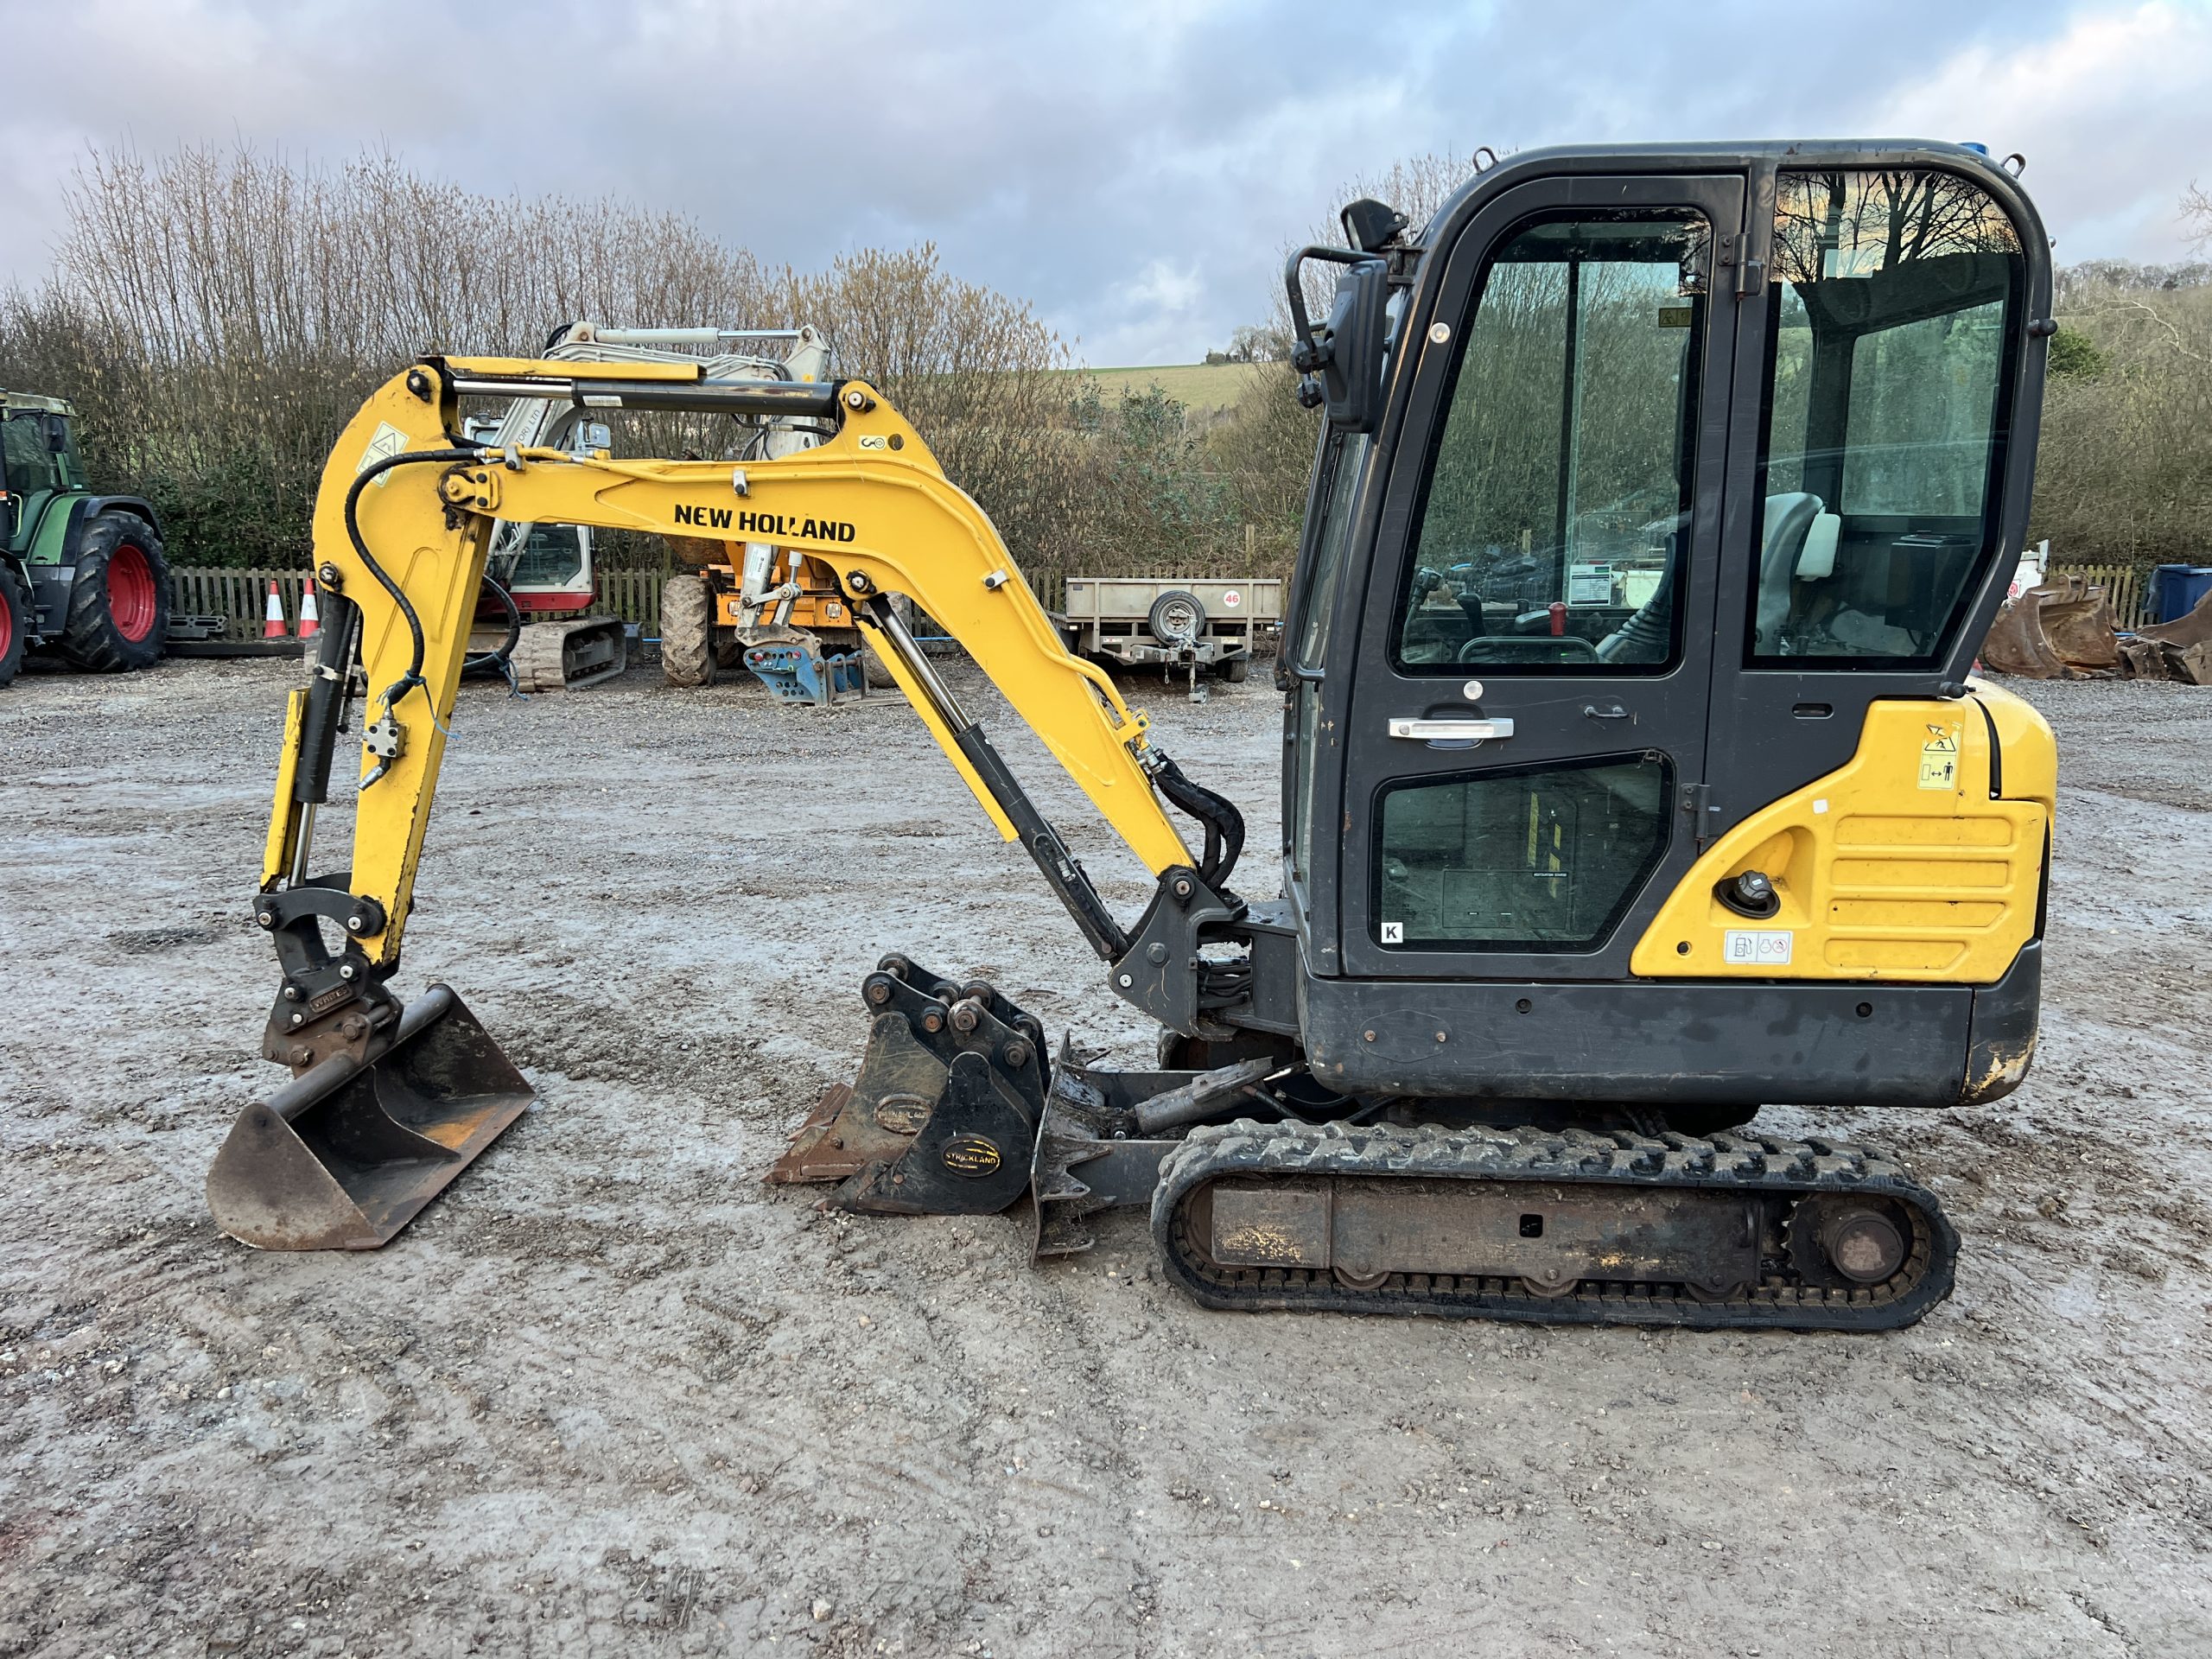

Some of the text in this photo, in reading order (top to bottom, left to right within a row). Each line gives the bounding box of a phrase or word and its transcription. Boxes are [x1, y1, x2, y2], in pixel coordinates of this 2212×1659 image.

[528, 409, 540, 426] LTD
[674, 504, 856, 543] NEW HOLLAND
[1225, 594, 1239, 603] 46
[1386, 925, 1397, 939] K
[313, 987, 350, 1008] WHITES
[945, 1152, 996, 1165] STRICKLAND
